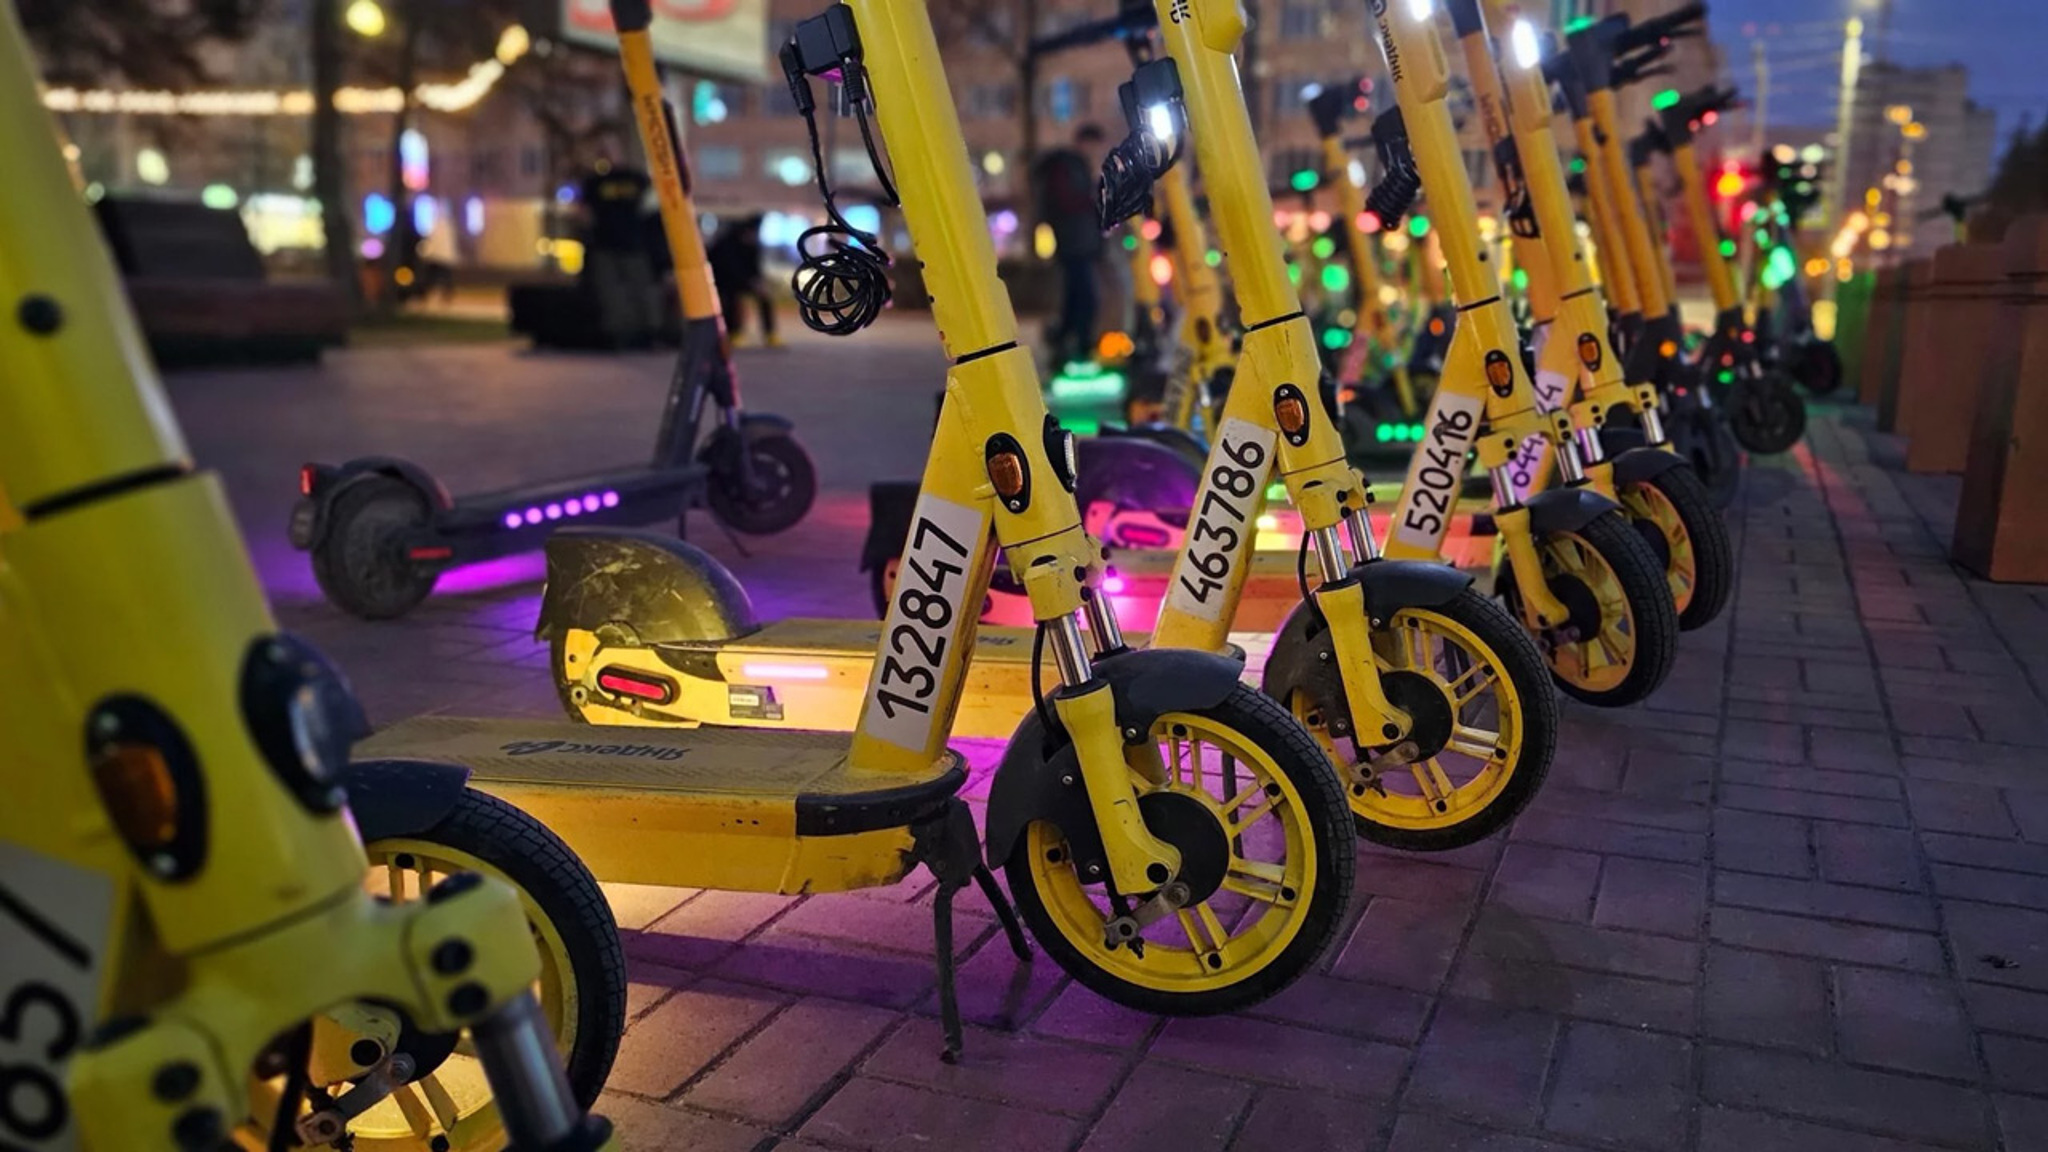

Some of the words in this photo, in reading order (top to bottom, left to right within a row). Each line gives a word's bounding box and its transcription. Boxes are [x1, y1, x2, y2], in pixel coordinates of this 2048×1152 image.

[1180, 437, 1265, 604] 463786
[1404, 408, 1473, 535] 520416
[876, 516, 969, 719] 132847
